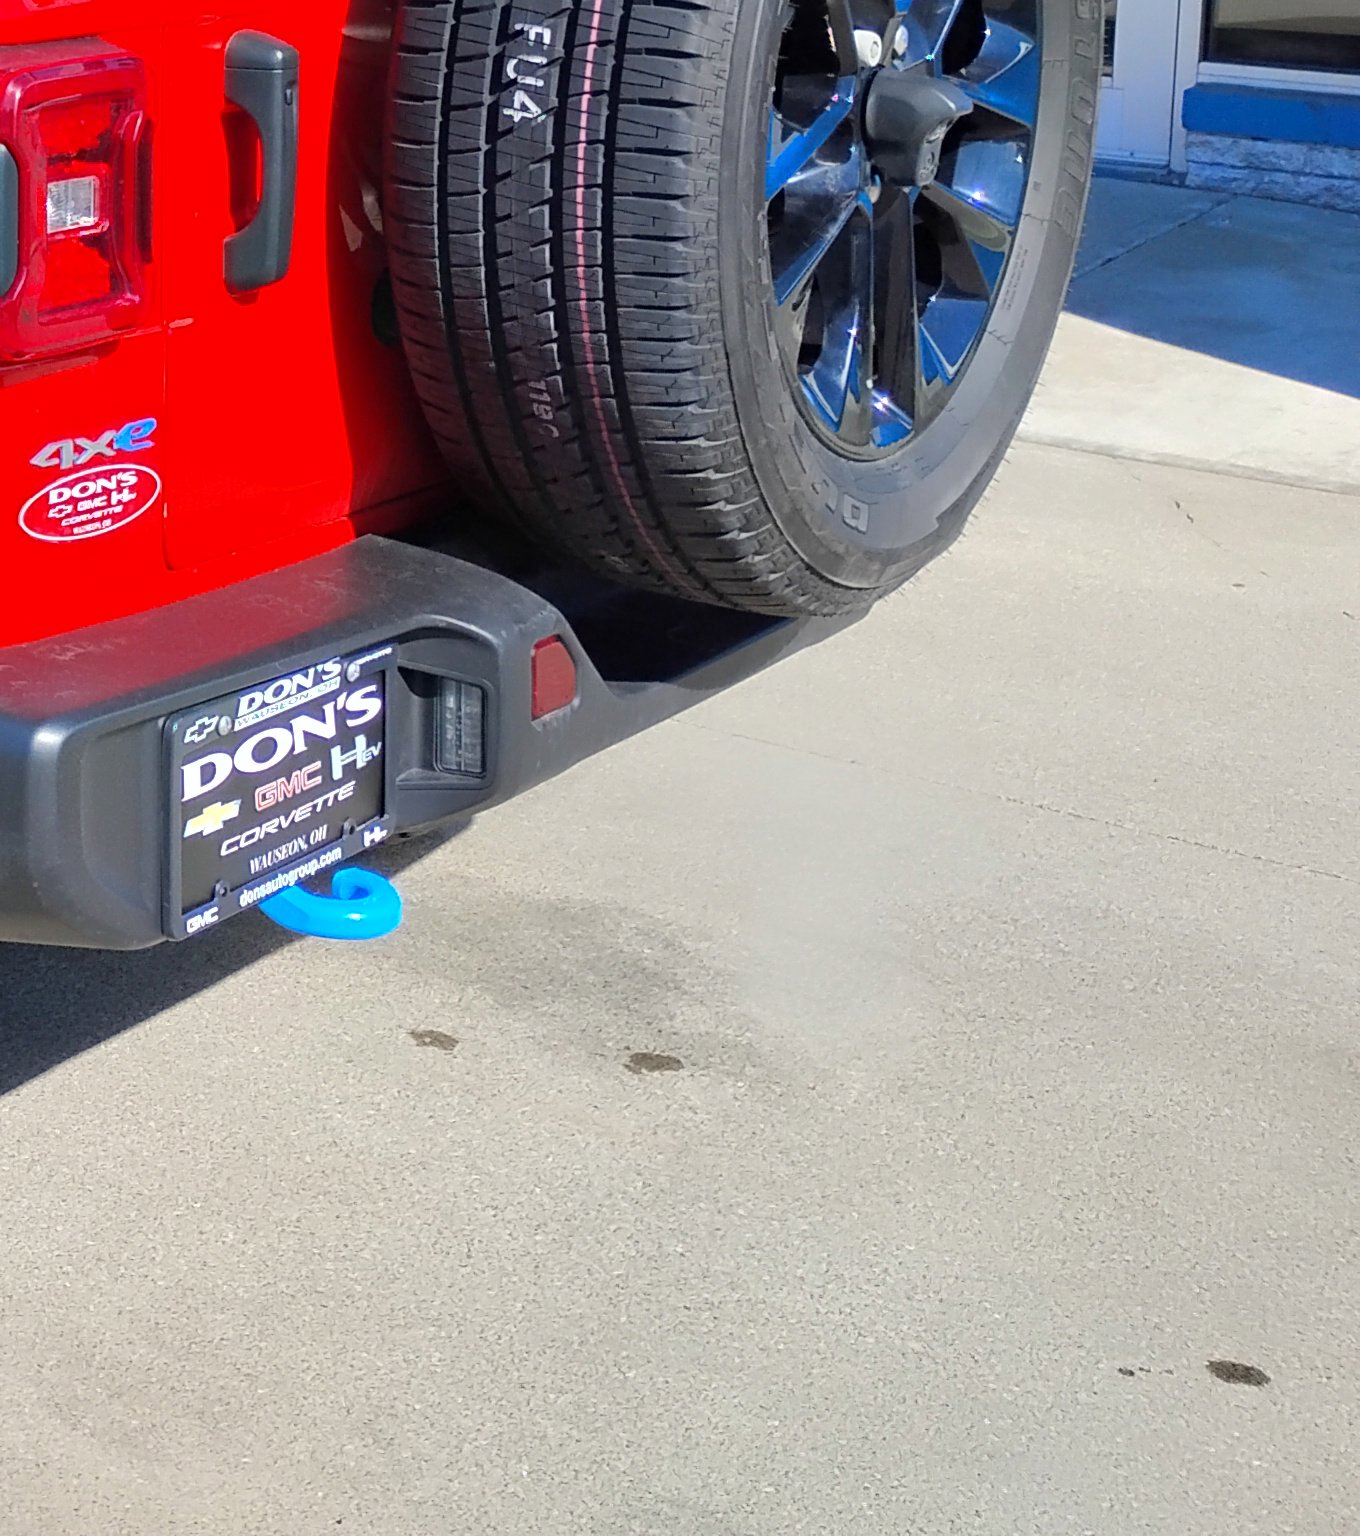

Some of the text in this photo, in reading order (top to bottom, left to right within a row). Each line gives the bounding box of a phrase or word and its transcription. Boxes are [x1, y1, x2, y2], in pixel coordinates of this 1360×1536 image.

[48, 470, 139, 506] DON'S
[237, 656, 342, 718] DON'S
[181, 684, 382, 802] DON'S
[254, 760, 323, 812] GMC
[220, 780, 356, 857] CORVETTE
[239, 846, 343, 907] donsautogroup.com
[249, 833, 307, 874] WAUSEON,
[309, 824, 329, 847] OH
[186, 907, 220, 934] GMC
